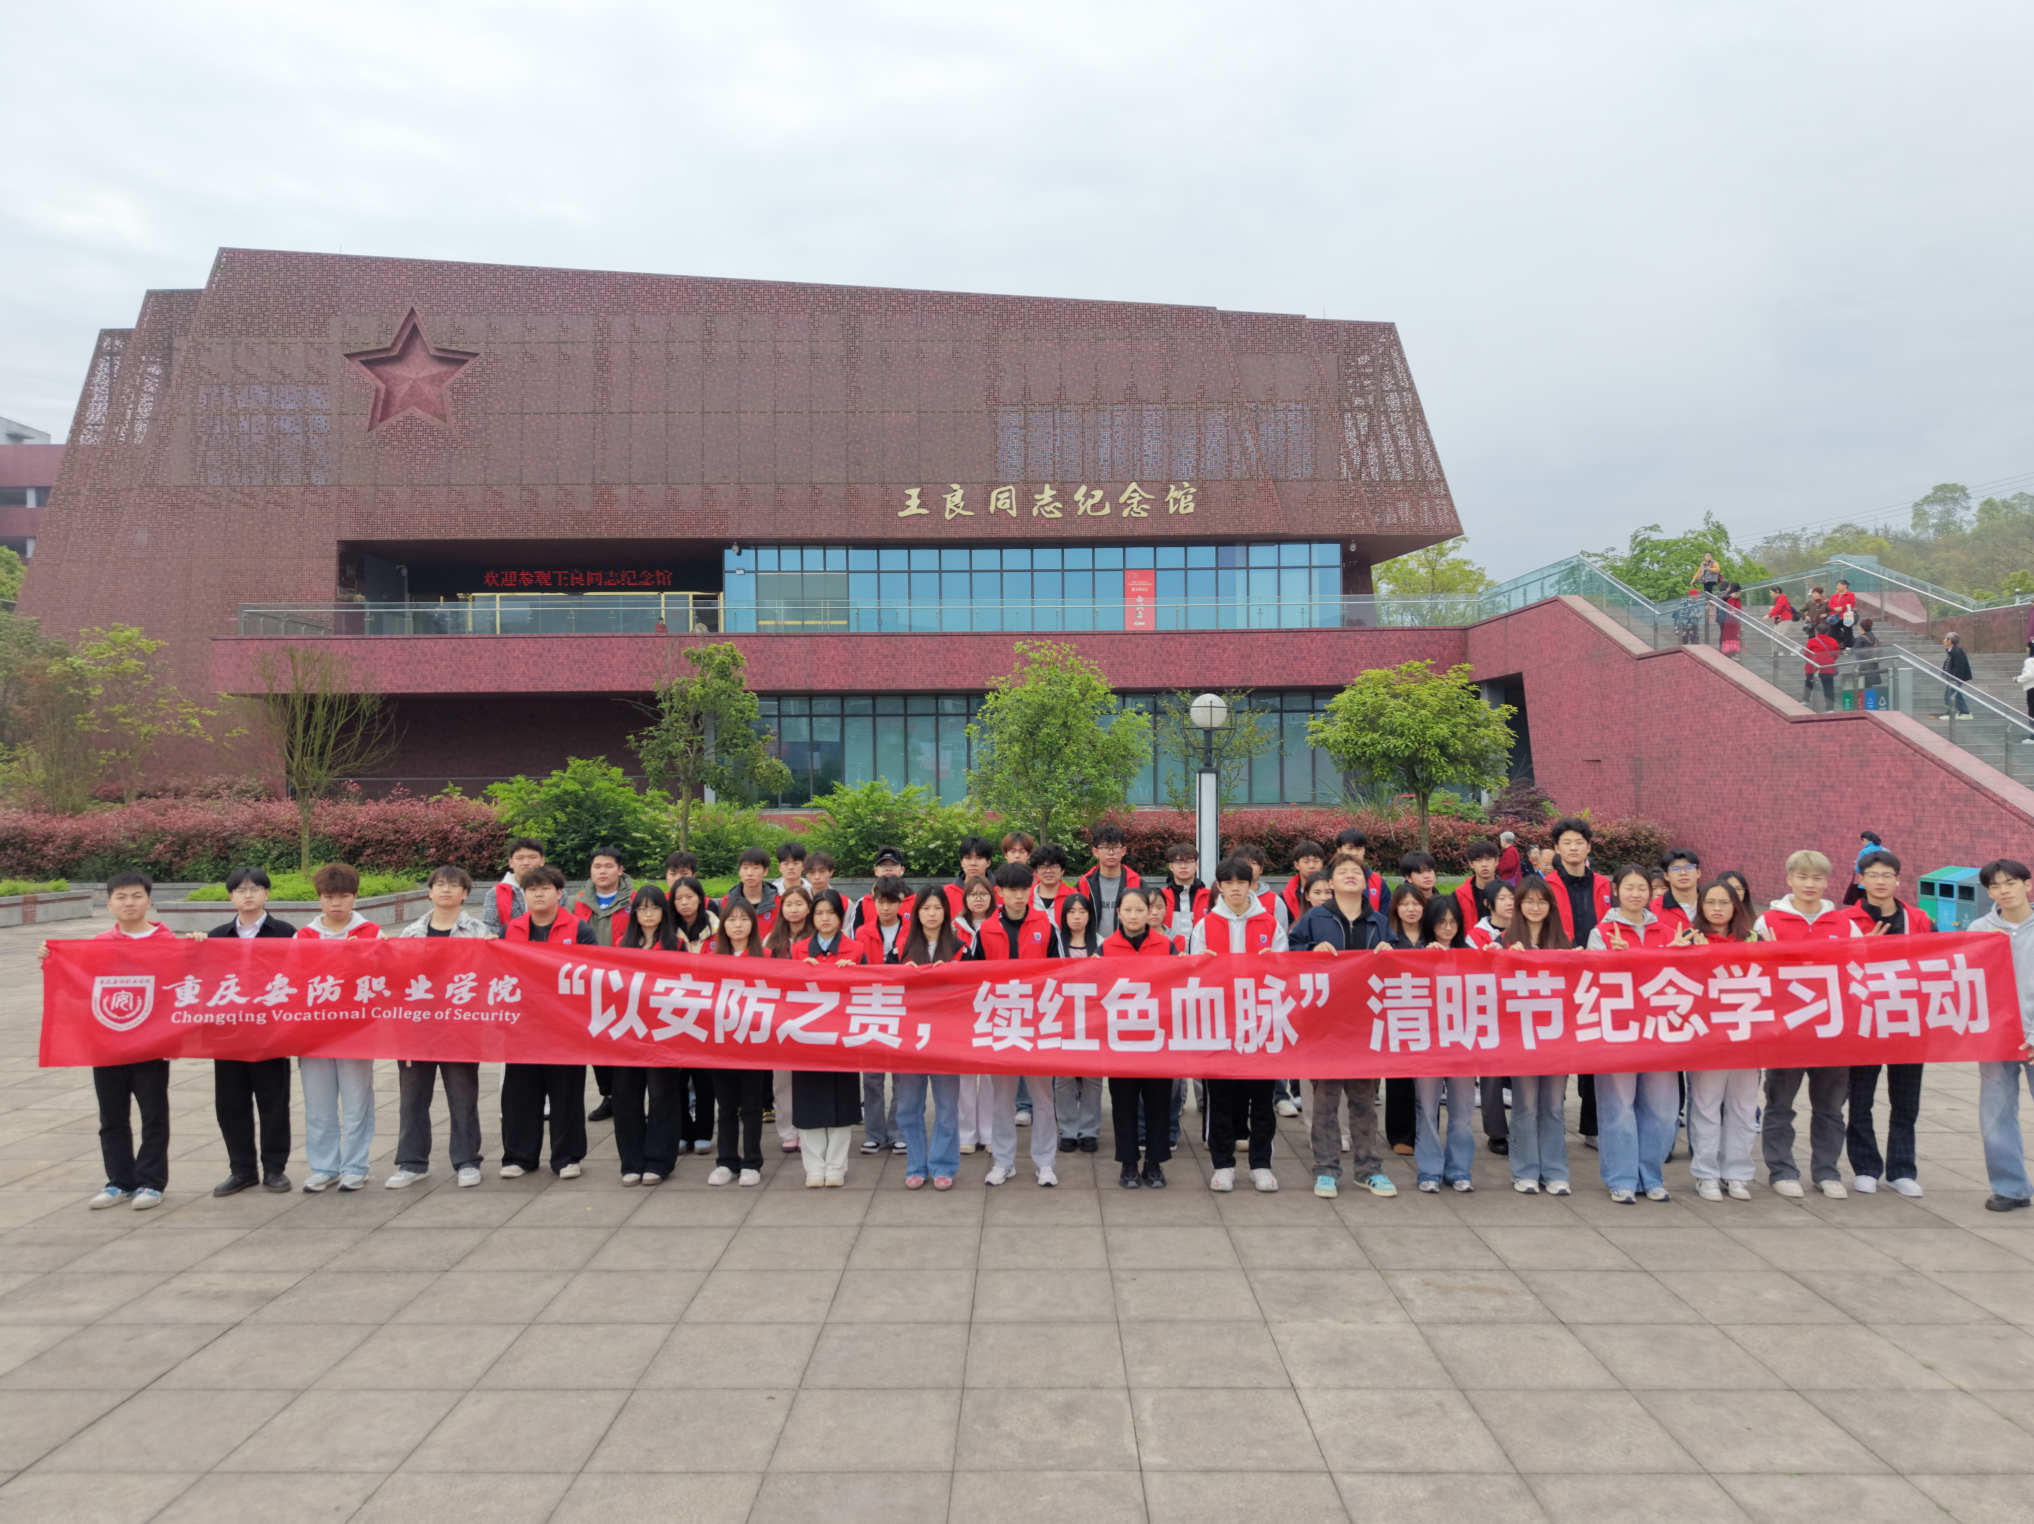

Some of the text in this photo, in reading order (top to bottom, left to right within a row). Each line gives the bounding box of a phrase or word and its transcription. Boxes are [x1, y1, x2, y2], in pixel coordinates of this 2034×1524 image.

[897, 481, 1198, 521] 王良同志纪念馆
[162, 972, 522, 1007] 重庆安防职业学院
[170, 1010, 267, 1025] Chongqing
[271, 1007, 367, 1021] Vocational
[370, 1006, 432, 1021] College
[434, 1007, 452, 1020] of
[452, 1007, 522, 1024] Security
